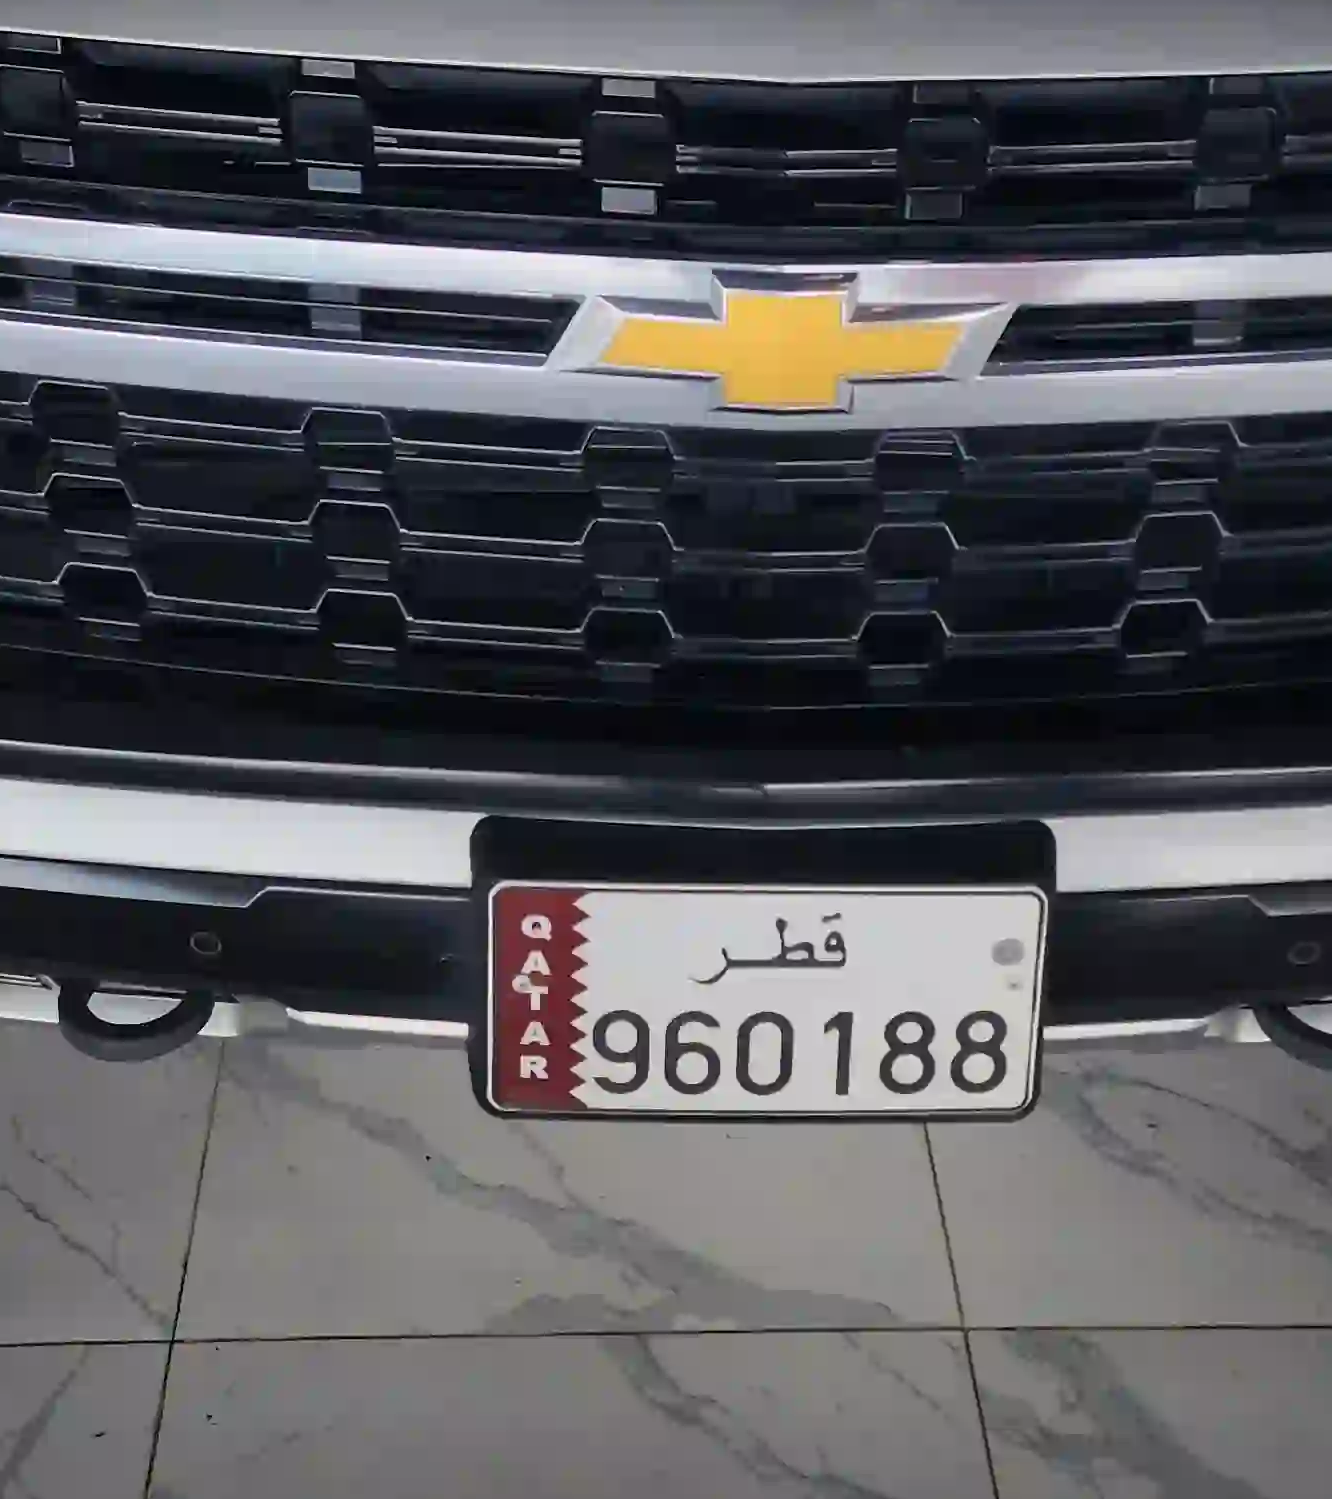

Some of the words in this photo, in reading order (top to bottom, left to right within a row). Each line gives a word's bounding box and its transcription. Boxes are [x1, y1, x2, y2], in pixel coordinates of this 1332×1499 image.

[688, 912, 848, 985] قطر
[519, 913, 553, 1080] QATAR
[591, 1008, 1008, 1097] 960188
